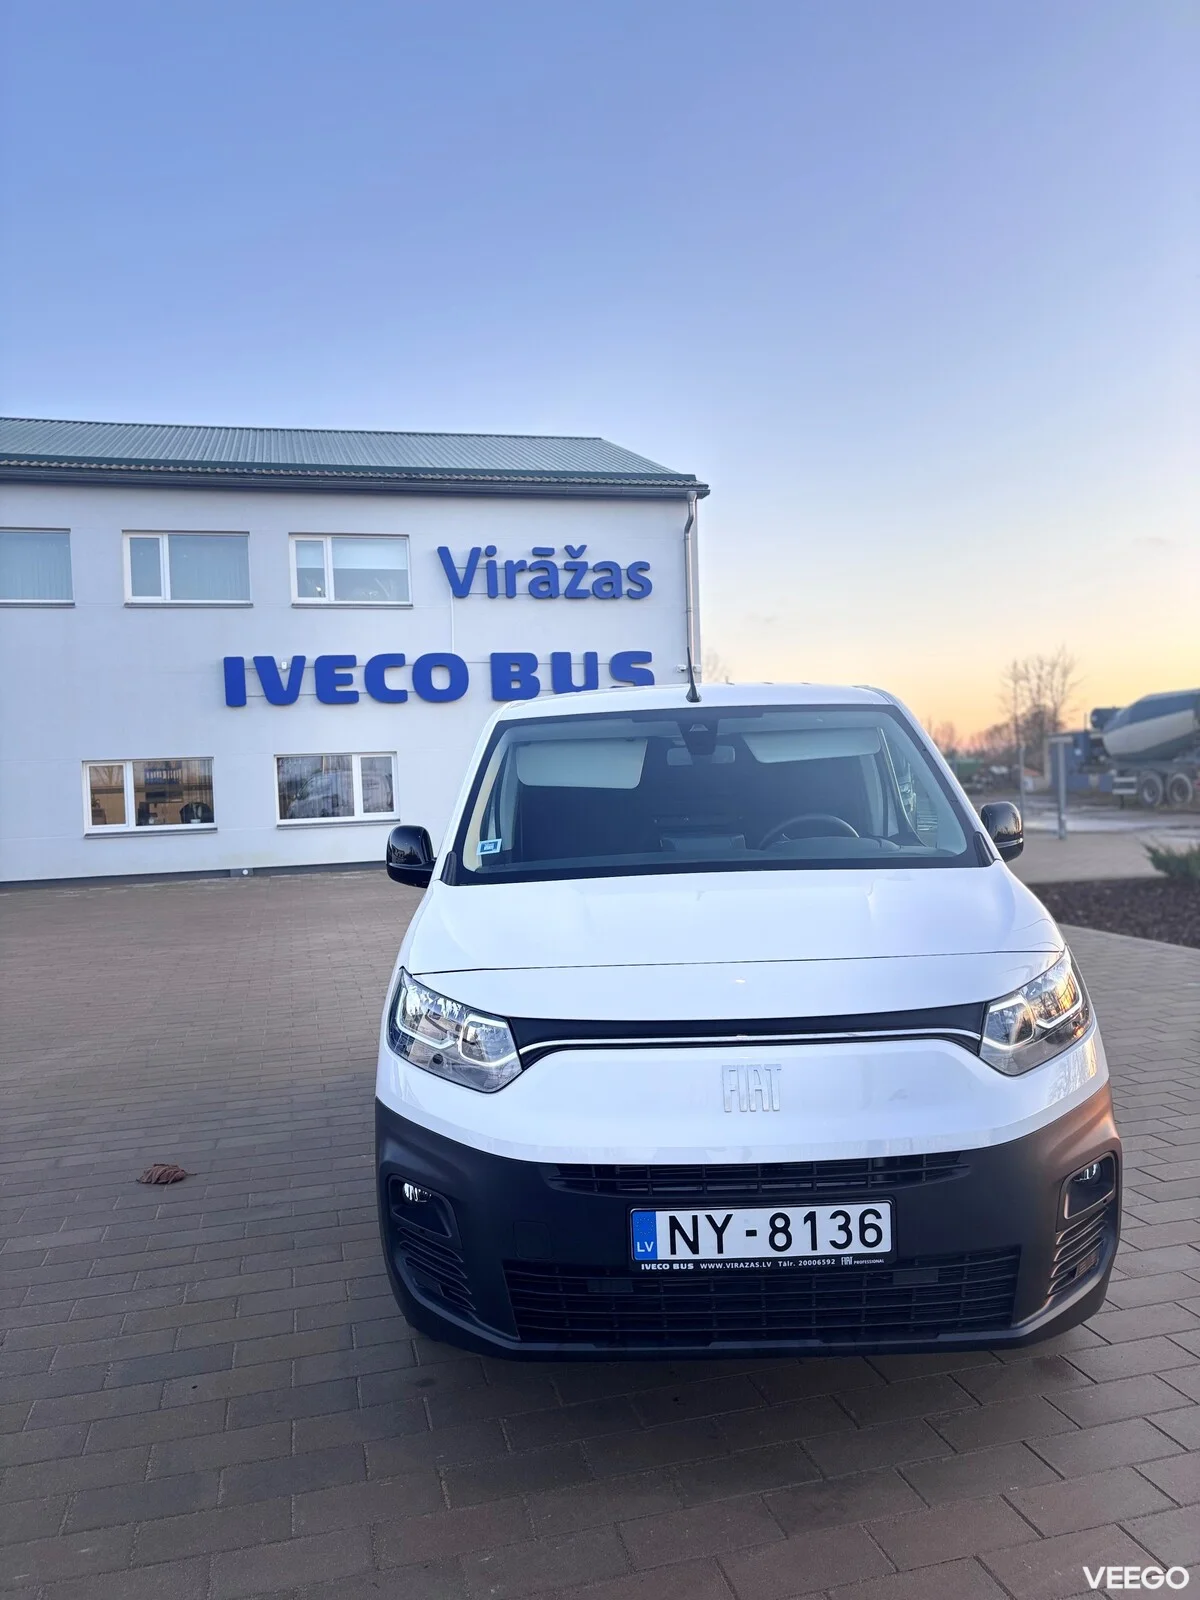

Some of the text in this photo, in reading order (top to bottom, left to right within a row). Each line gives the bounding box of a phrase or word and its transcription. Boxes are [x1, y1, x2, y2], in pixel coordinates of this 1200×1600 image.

[437, 544, 653, 599] Virāžas
[223, 651, 655, 707] IVECO BUS
[722, 1064, 782, 1112] FIAT
[636, 1241, 654, 1253] LV
[668, 1208, 883, 1255] NY-8136
[700, 1261, 772, 1269] WWW.VIRAZAS.LV
[841, 1256, 853, 1266] FIAT
